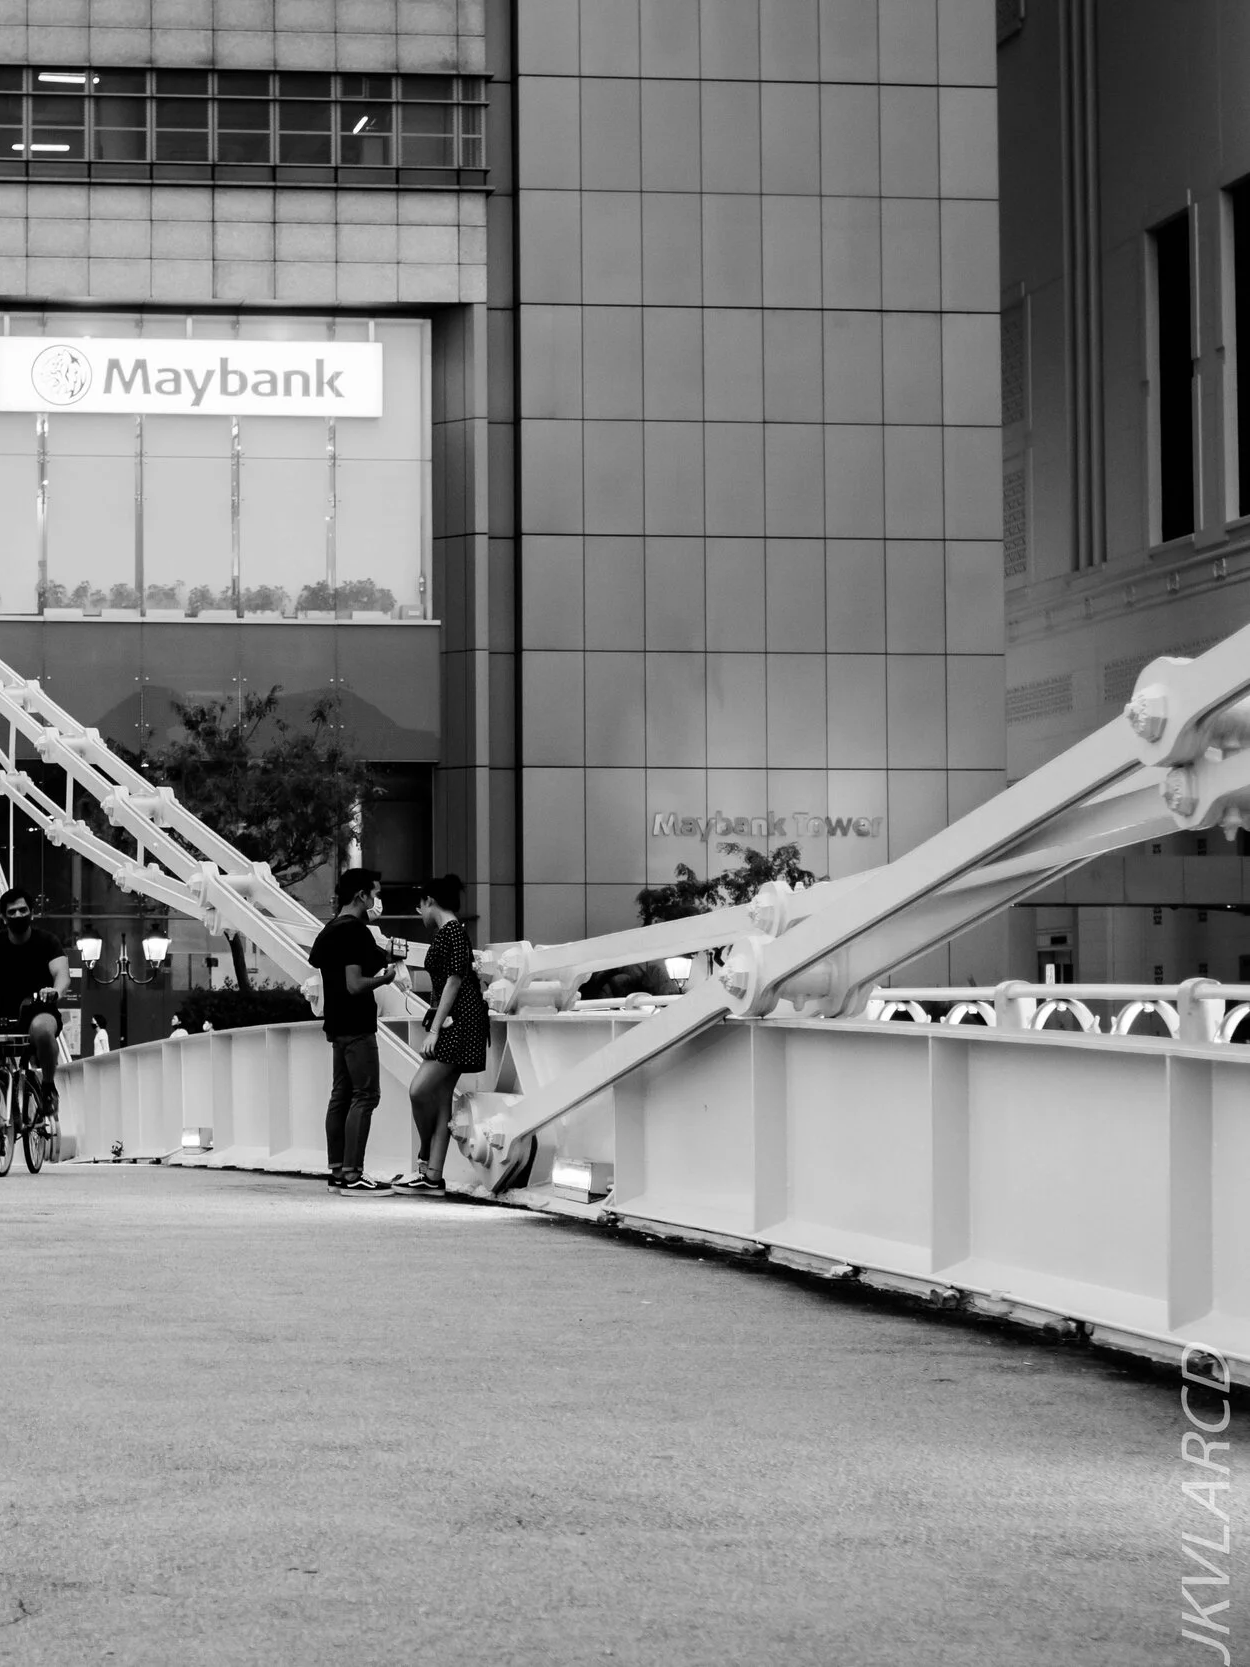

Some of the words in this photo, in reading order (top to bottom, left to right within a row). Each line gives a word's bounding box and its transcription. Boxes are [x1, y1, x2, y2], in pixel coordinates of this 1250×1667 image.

[102, 357, 346, 407] Maybank
[652, 810, 788, 842] Maybank
[792, 811, 884, 838] Tower
